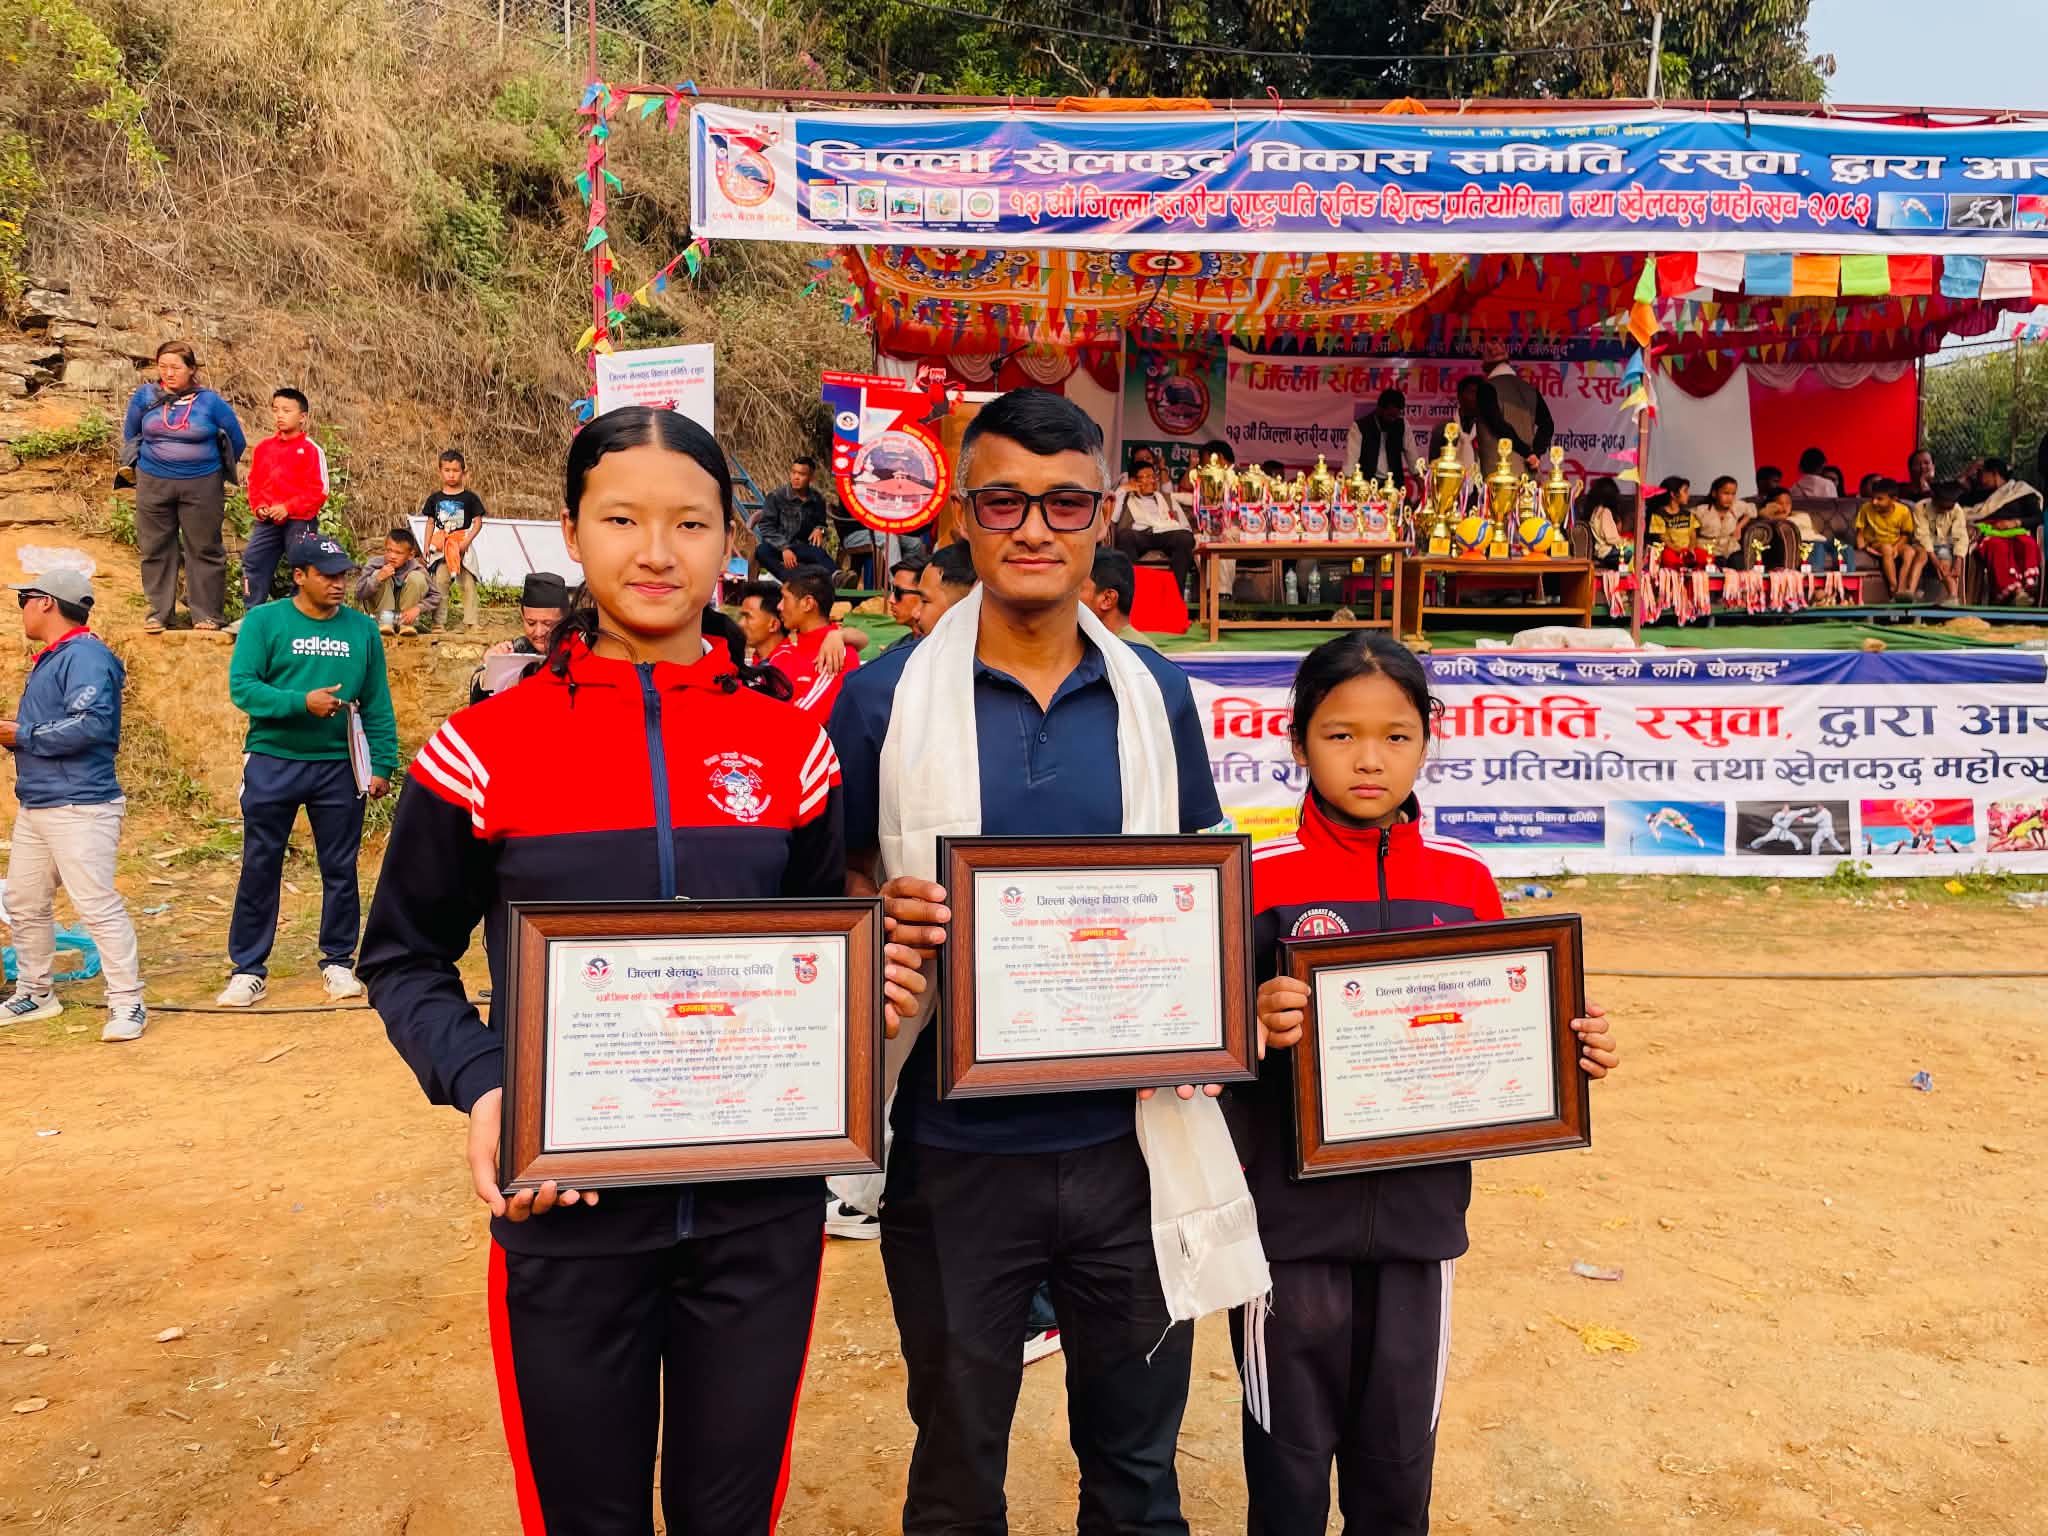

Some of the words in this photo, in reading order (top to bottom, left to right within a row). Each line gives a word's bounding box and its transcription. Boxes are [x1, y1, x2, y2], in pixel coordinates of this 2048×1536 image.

[807, 139, 994, 175] जिल्ला
[1013, 142, 1227, 180] खेलकुद
[1249, 141, 1433, 175] विकास
[1829, 154, 1946, 184] द्वारा
[1962, 156, 2048, 181] आ
[1010, 191, 1041, 224] १३
[1079, 183, 1152, 223] जिल्ला
[1153, 183, 1227, 228] स्तरीय
[1229, 182, 1318, 228] राष्ट्रपति
[1381, 183, 1443, 225] शिल्ड
[1443, 183, 1562, 226] प्रतियोगिता
[1569, 190, 1616, 217] तथा
[1618, 182, 1710, 228] खेलकुद
[292, 636, 350, 652] adidas
[1433, 659, 1479, 678] लागि
[1487, 658, 1566, 683] खेलकुद,
[1576, 658, 1643, 681] राष्ट्रको
[1651, 658, 1699, 679] लागि
[1818, 704, 1937, 748] द्वारा
[1957, 705, 2048, 737] आ
[1481, 749, 1677, 786] प्रतियोगिता
[1692, 758, 1767, 783] तथा
[1774, 749, 1925, 790] खेलकुद
[1932, 748, 2048, 785] महोत्स
[627, 967, 661, 981] जिल्ला
[664, 965, 704, 981] खेलकुद
[706, 964, 740, 979] विकास
[742, 962, 775, 978] समिति
